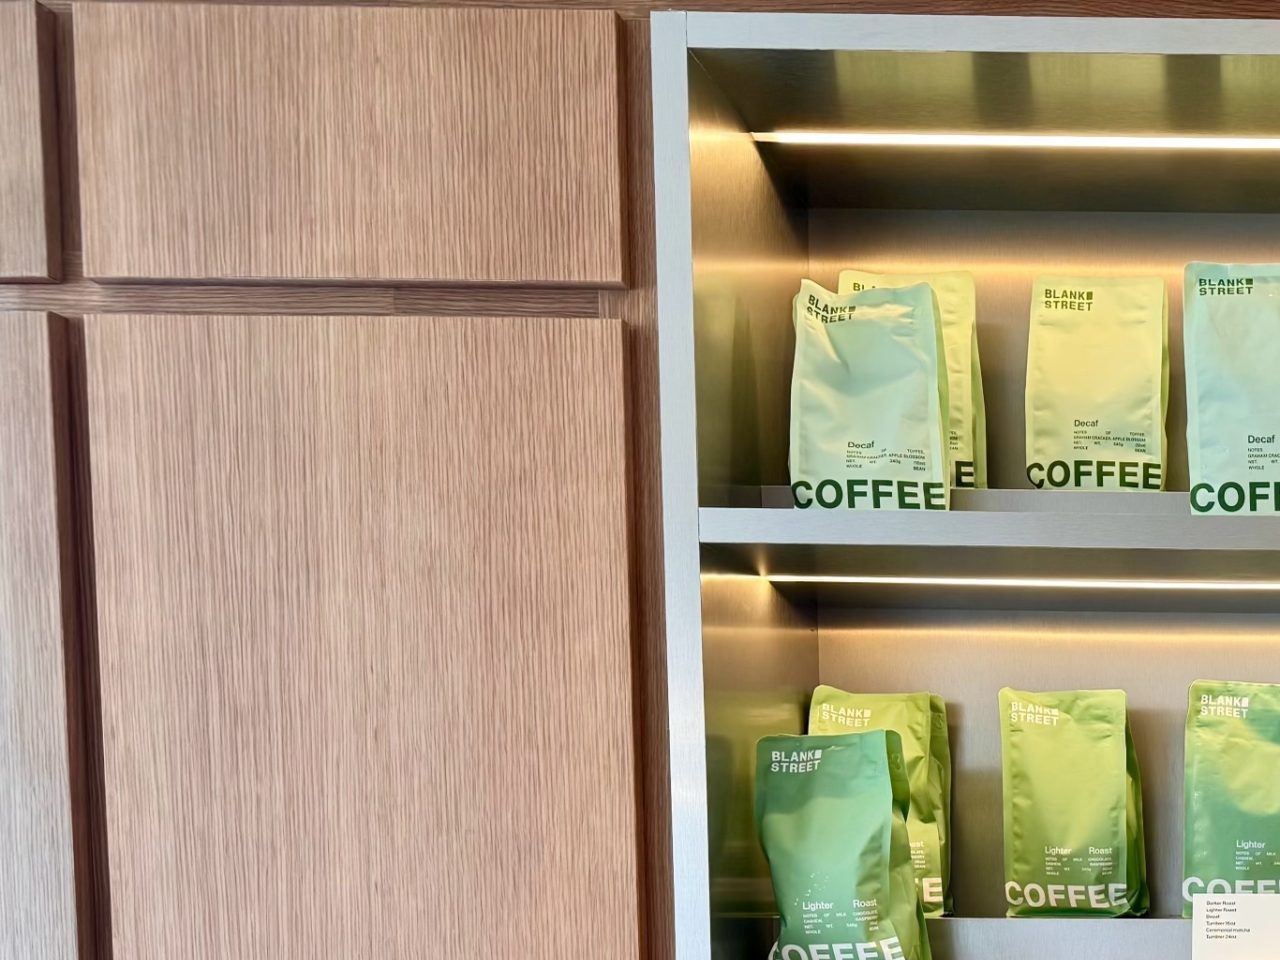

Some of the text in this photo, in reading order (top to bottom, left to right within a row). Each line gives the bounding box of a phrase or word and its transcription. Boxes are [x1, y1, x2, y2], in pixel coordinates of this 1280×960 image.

[1199, 278, 1244, 287] BLANK
[1044, 289, 1085, 300] BLANK
[1199, 286, 1253, 296] STREET
[808, 295, 848, 314] BLANK
[1044, 300, 1092, 312] STREET
[807, 306, 854, 323] STREET
[1074, 420, 1098, 428] Decaf
[848, 440, 874, 449] Decaf
[1248, 435, 1275, 444] Decaf
[1027, 460, 1161, 489] COFFEE
[792, 479, 946, 510] COFFEE
[1201, 695, 1242, 707] BLANK
[822, 703, 863, 718] BLANK
[1011, 702, 1052, 715] BLANK
[1200, 706, 1248, 718] STREET
[821, 712, 870, 727] STREET
[1010, 712, 1059, 726] STREET
[771, 751, 814, 762] BLANK
[770, 760, 821, 773] STREET
[1045, 846, 1112, 856] Lighter Roast
[1236, 840, 1266, 850] Lighter
[1005, 881, 1128, 908] COFFEE
[802, 898, 877, 912] Lighter Roast
